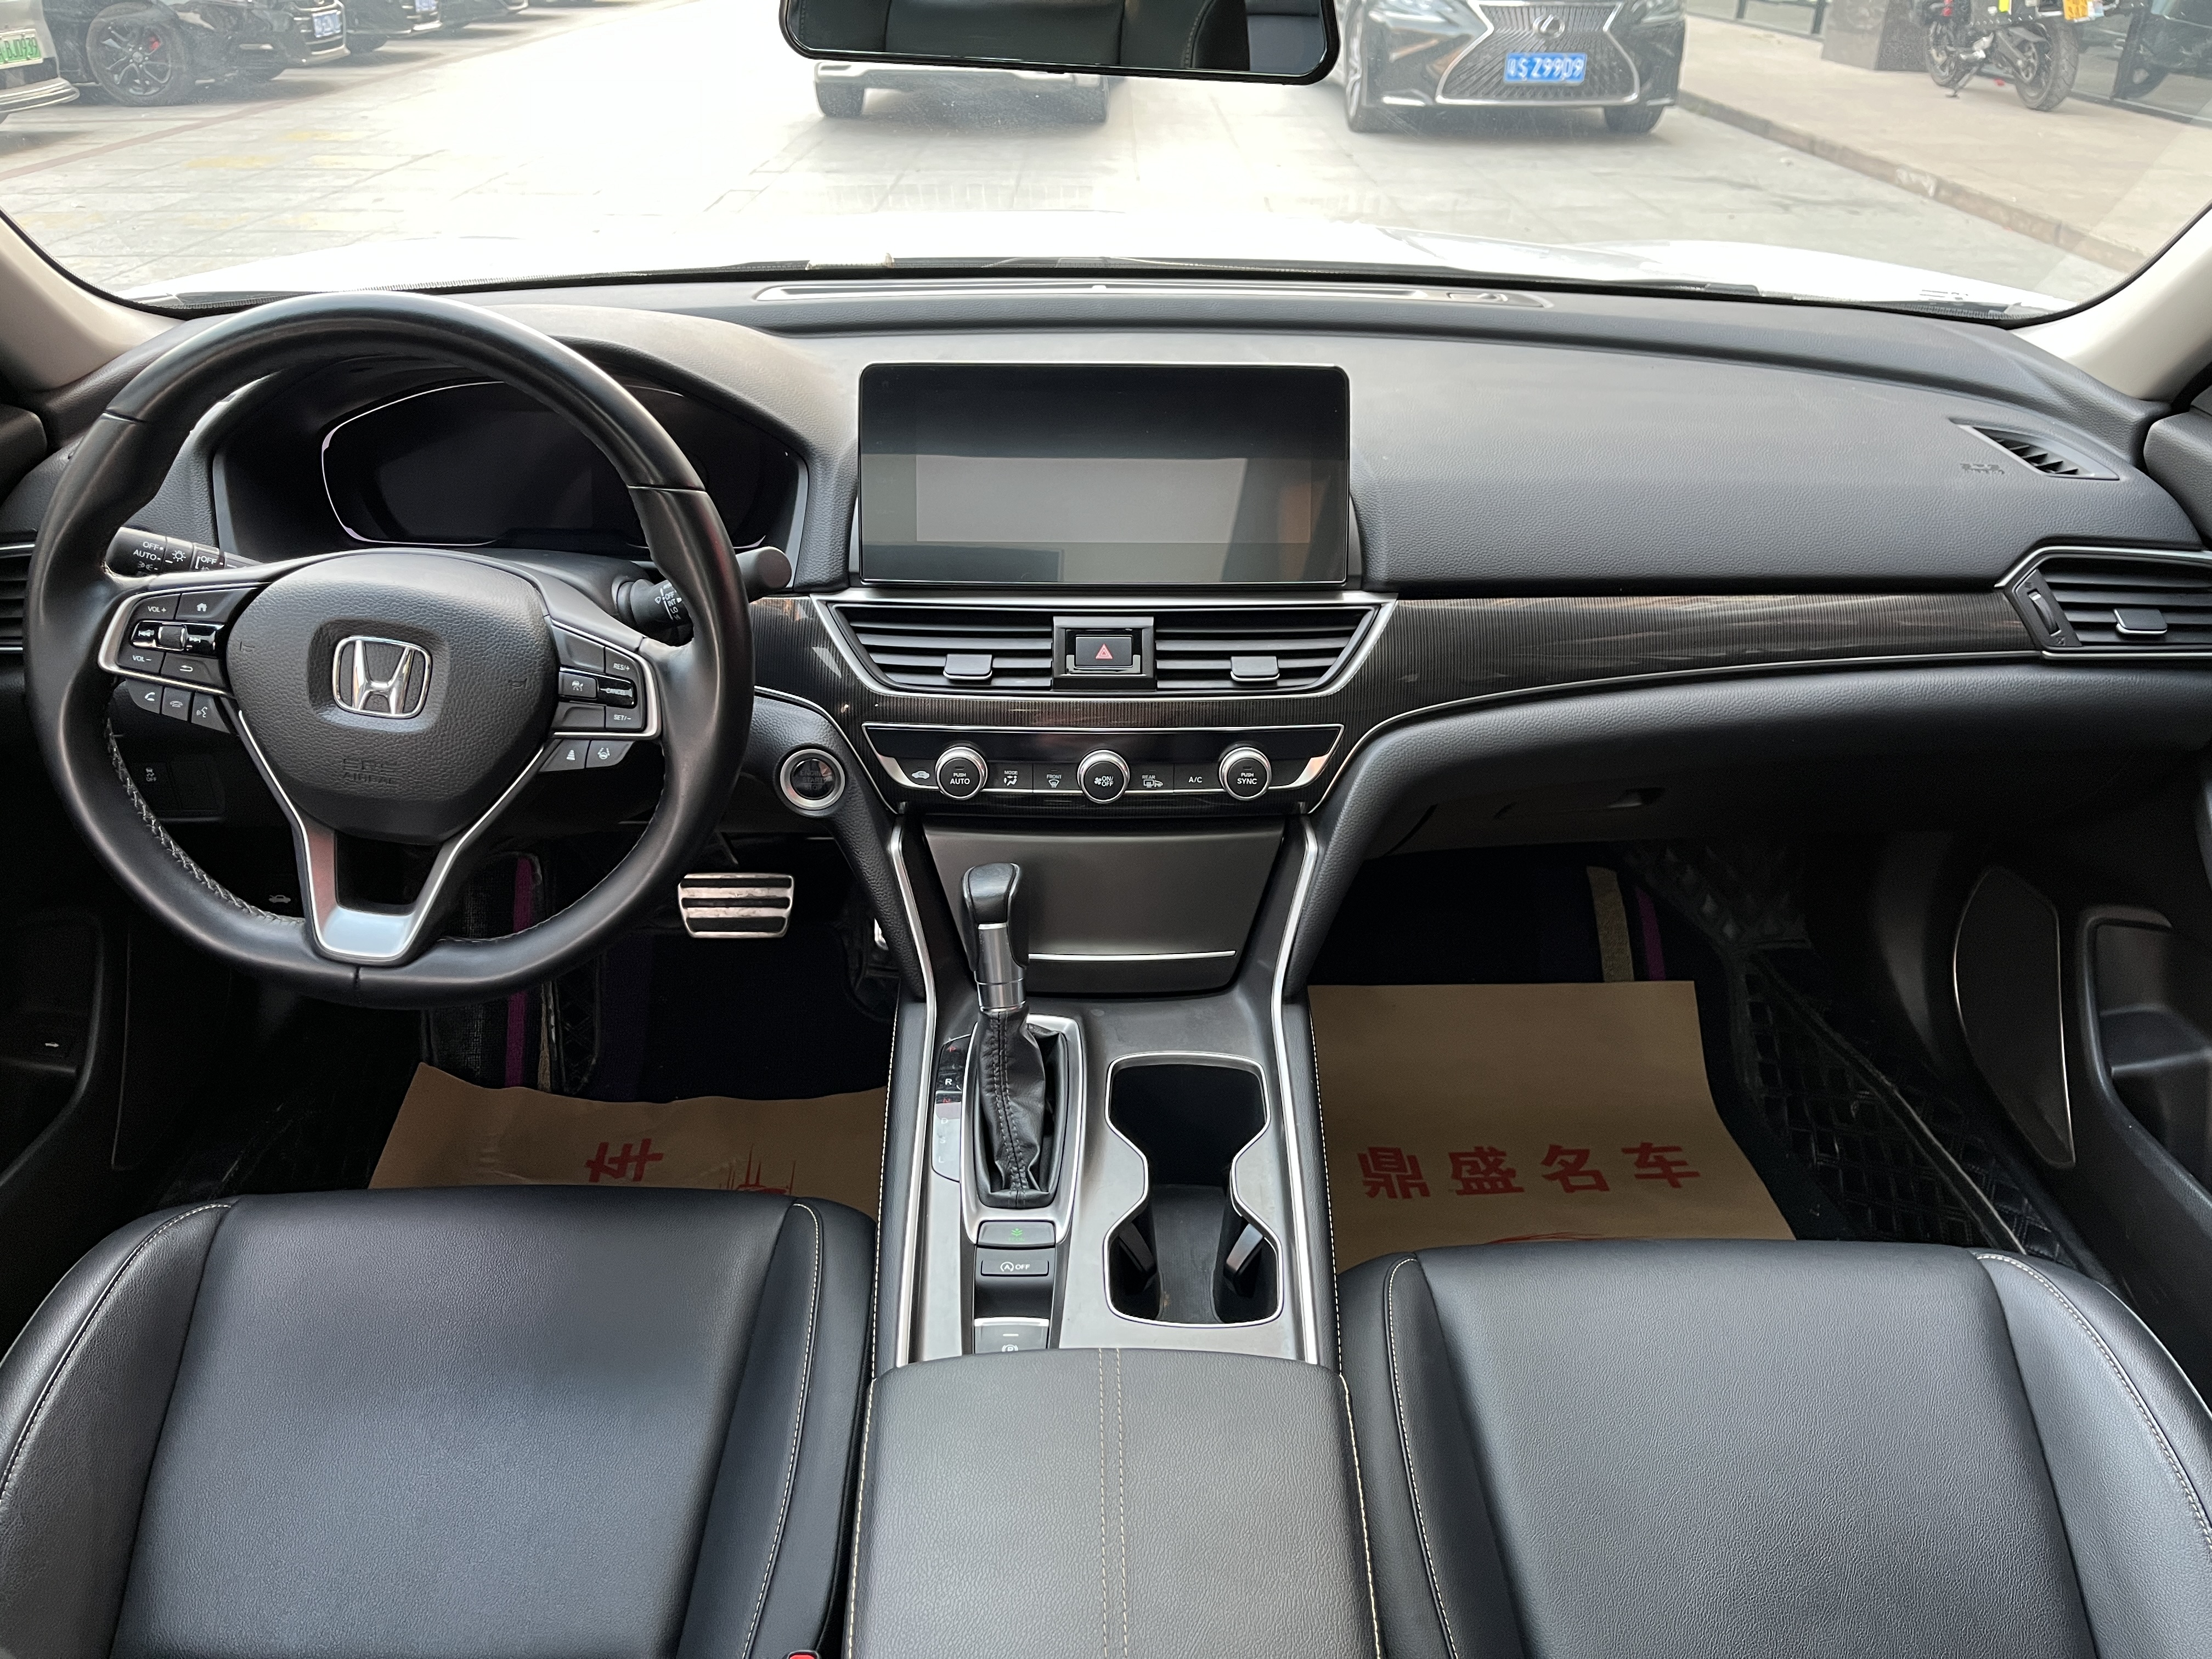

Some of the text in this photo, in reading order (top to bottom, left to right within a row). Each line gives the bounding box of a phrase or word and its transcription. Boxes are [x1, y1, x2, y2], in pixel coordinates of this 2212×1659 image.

[143, 541, 159, 550] OFF
[133, 549, 157, 561] AUTO
[200, 555, 217, 565] OFF
[664, 591, 675, 600] OFF
[1358, 1142, 1702, 1200] 鼎盛名车
